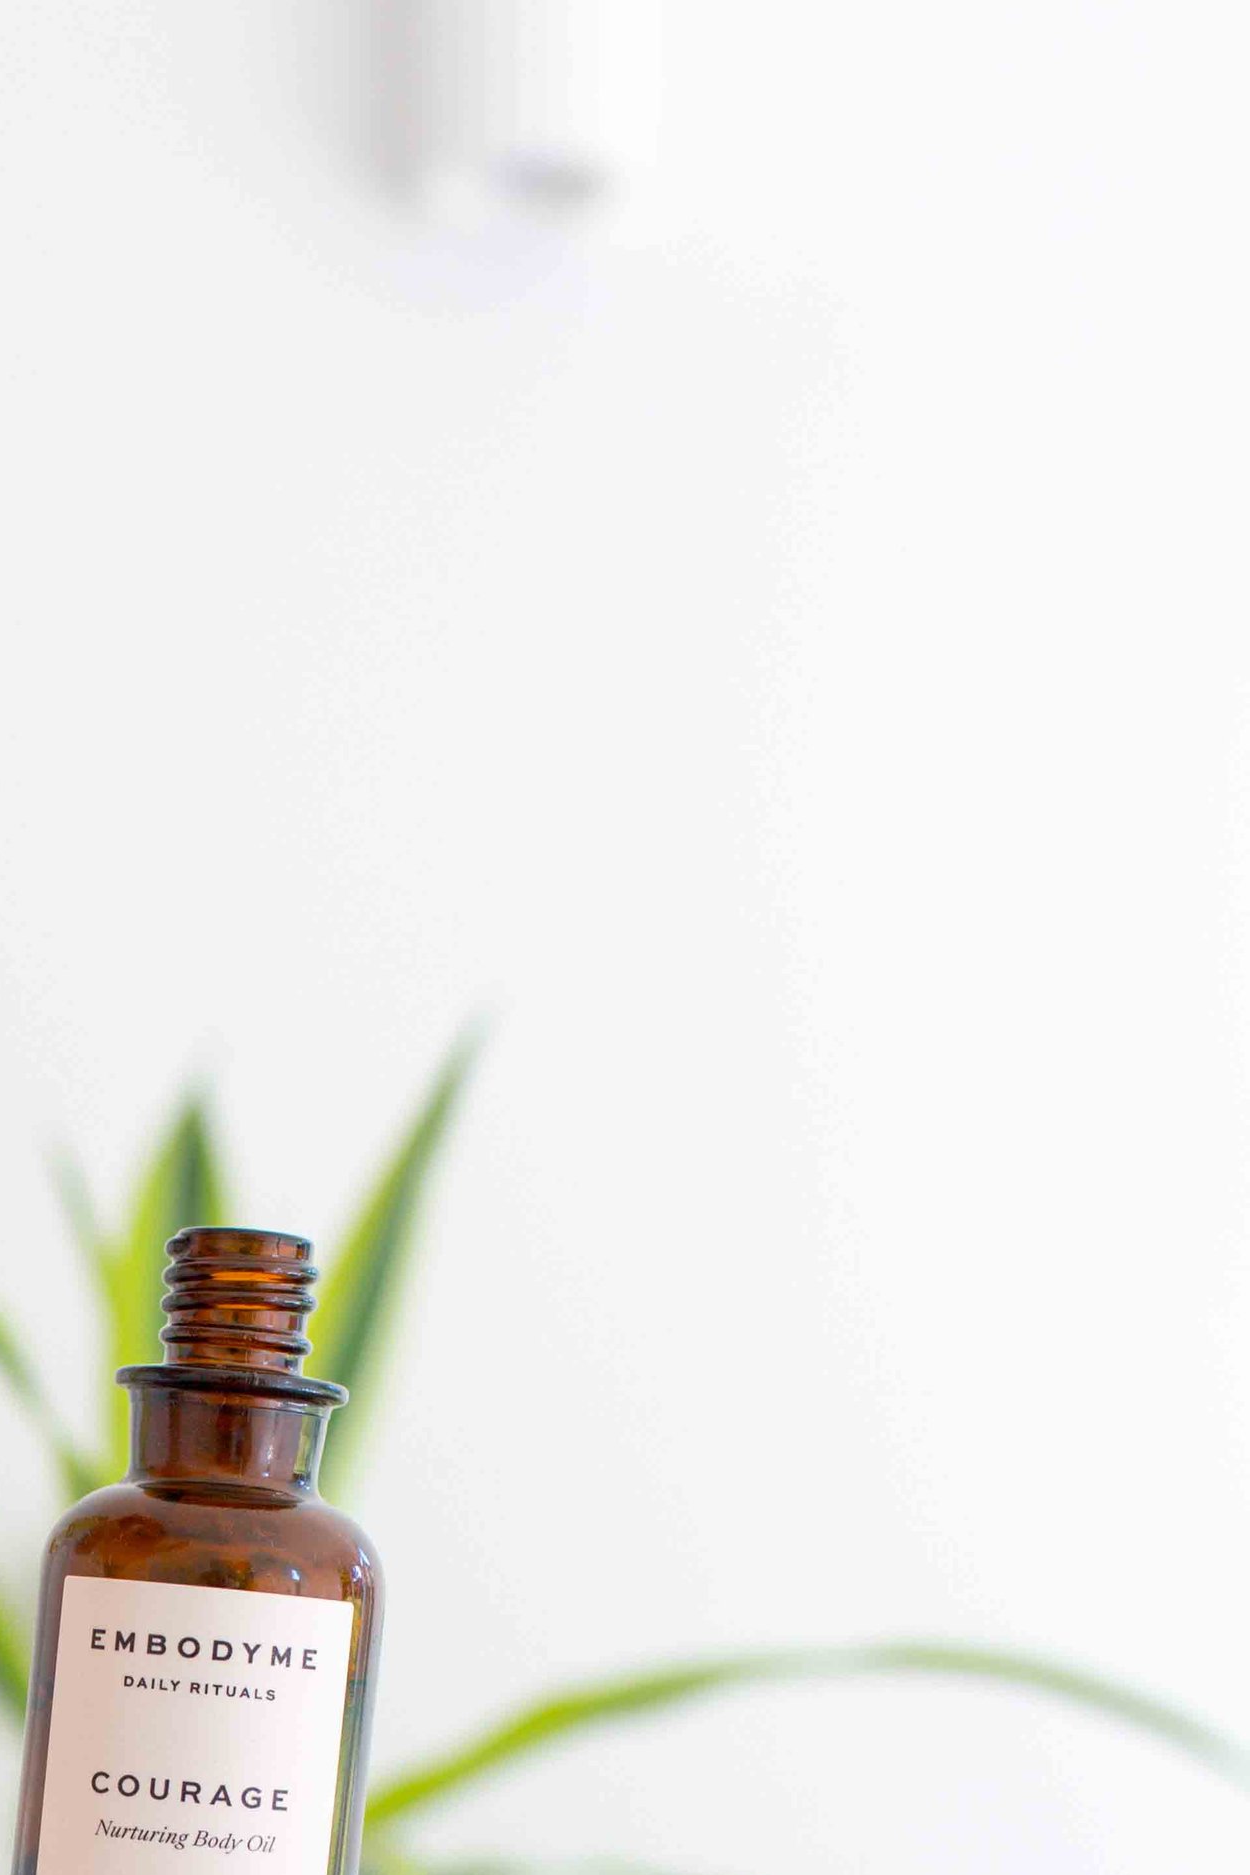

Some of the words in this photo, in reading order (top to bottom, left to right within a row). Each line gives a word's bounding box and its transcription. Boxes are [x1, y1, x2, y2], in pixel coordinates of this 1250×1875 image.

[90, 1628, 318, 1671] EMBODYME
[123, 1675, 181, 1692] DAILY
[189, 1682, 276, 1701] RITUALS
[91, 1771, 290, 1812] COURAGE
[94, 1818, 190, 1850] Nurturing
[193, 1829, 244, 1854] Body
[246, 1834, 277, 1853] Oil
